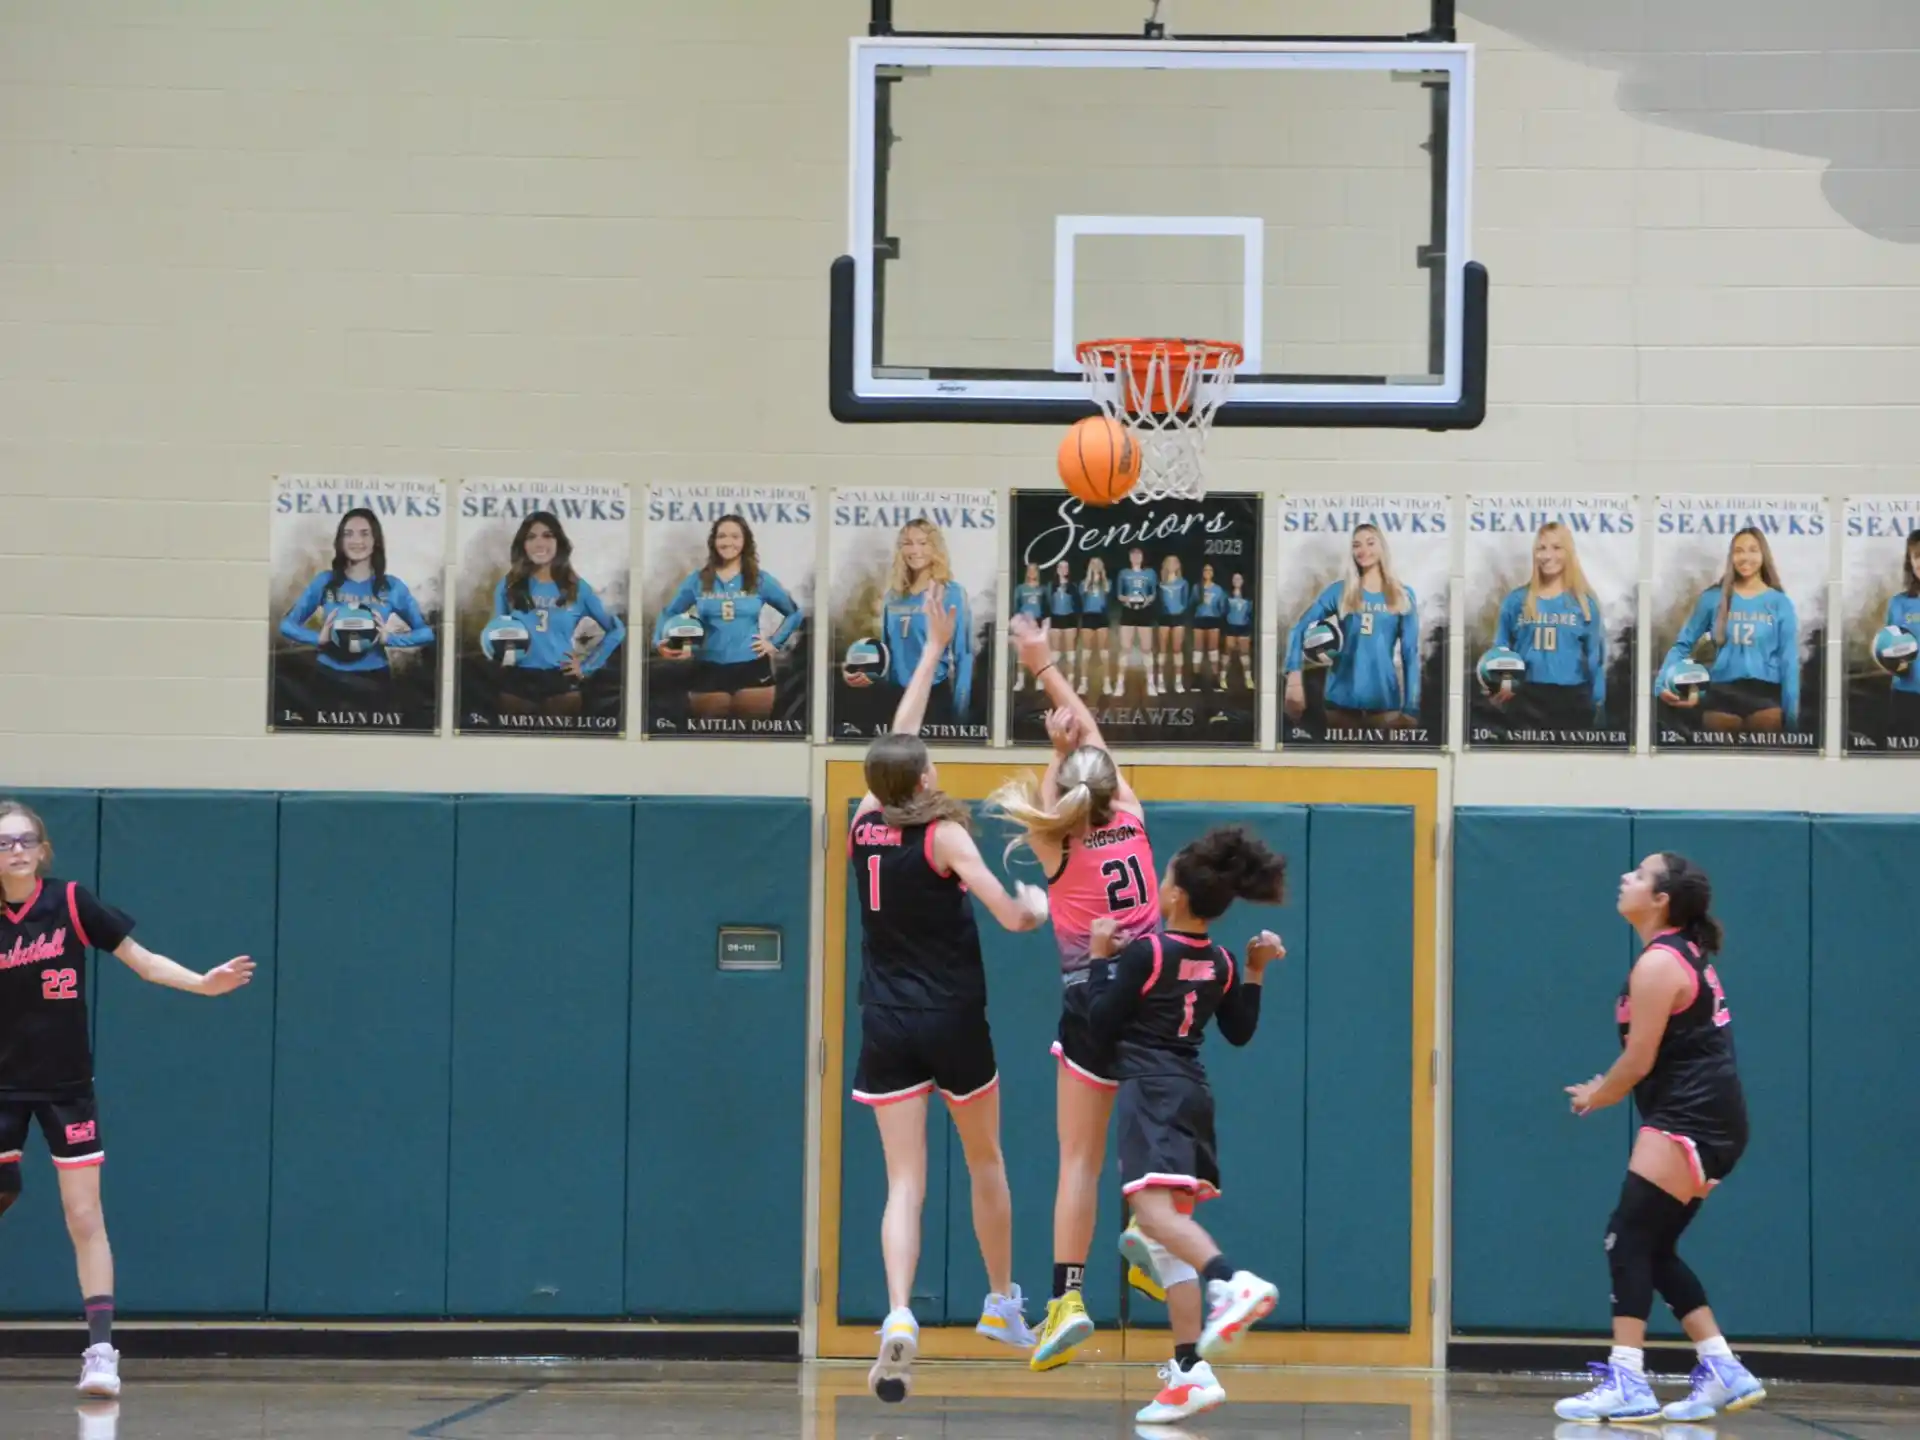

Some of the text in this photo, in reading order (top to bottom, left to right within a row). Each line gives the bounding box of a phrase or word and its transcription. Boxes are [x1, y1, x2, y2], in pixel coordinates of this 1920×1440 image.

[344, 479, 380, 491] HIGH
[530, 483, 566, 495] HIGH
[716, 486, 750, 498] HIGH
[275, 493, 442, 518] SEAHAWKS
[902, 490, 936, 503] HIGH
[1349, 497, 1386, 510] HIGH
[1537, 497, 1574, 510] HIGH
[1725, 498, 1762, 511] HIGH
[461, 496, 627, 521] SEAHAWKS
[647, 501, 812, 525] SEAHAWKS
[834, 506, 997, 529] SEAHAWKS
[1024, 496, 1234, 570] Seniors
[1283, 512, 1448, 534] SEAHAWKS
[1469, 512, 1635, 534] SEAHAWKS
[1656, 512, 1826, 536] SEAHAWKS
[1204, 539, 1242, 556] 2023
[535, 609, 549, 633] 3
[900, 614, 912, 638] 7
[1359, 612, 1374, 635] 9
[1533, 626, 1557, 650] 10
[1733, 622, 1756, 645] 12
[284, 710, 404, 725] 1 KALYN DAY
[470, 712, 618, 729] 3 MARYANNE LUGO
[656, 717, 803, 732] 6 KAITLIN DORAN
[1091, 707, 1195, 726] EAHAWKS
[843, 722, 852, 735] 7
[920, 724, 989, 738] STRYKER
[1292, 728, 1429, 743] 9 JILLIAN BETZ
[1473, 728, 1627, 744] 10 ASHLEY VANDIVER
[1660, 731, 1815, 746] 12 EMMA SARHADDI
[1083, 825, 1138, 850] GIBSON
[867, 854, 881, 912] 1
[1100, 853, 1149, 913] 21
[41, 967, 78, 1000] 22
[1177, 989, 1198, 1037] 1
